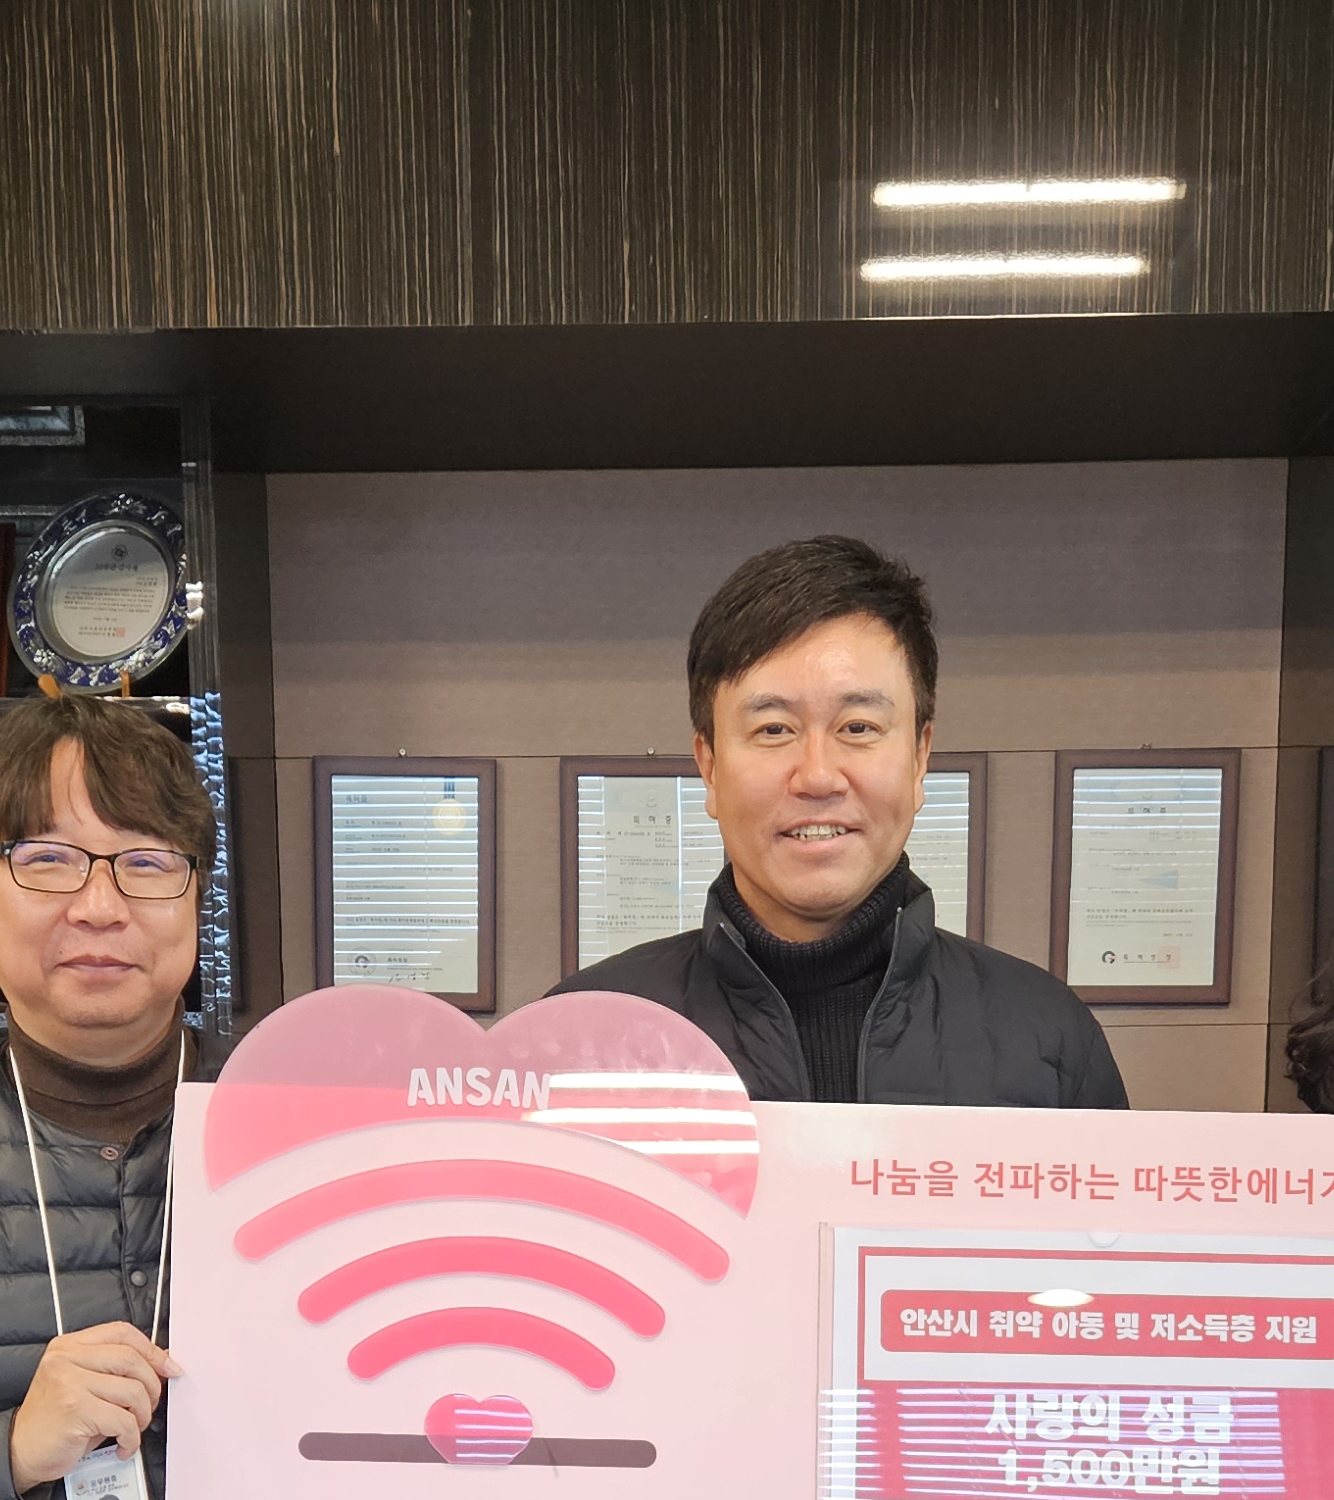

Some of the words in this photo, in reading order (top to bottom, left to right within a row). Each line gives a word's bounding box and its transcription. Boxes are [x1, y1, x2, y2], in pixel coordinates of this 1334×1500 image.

[406, 1067, 551, 1112] ANSAN
[850, 1158, 960, 1197] 나눔을
[973, 1161, 1120, 1200] 전파하는
[899, 1308, 978, 1337] 안산시
[989, 1310, 1043, 1339] 취약
[1052, 1312, 1104, 1340] 아동
[1115, 1313, 1140, 1342] 및
[1151, 1313, 1256, 1344] 저소득층
[1265, 1315, 1317, 1344] 지원
[984, 1392, 1121, 1443] 사랑의
[1141, 1394, 1234, 1444] 성금
[997, 1447, 1221, 1495] 1,500만원
